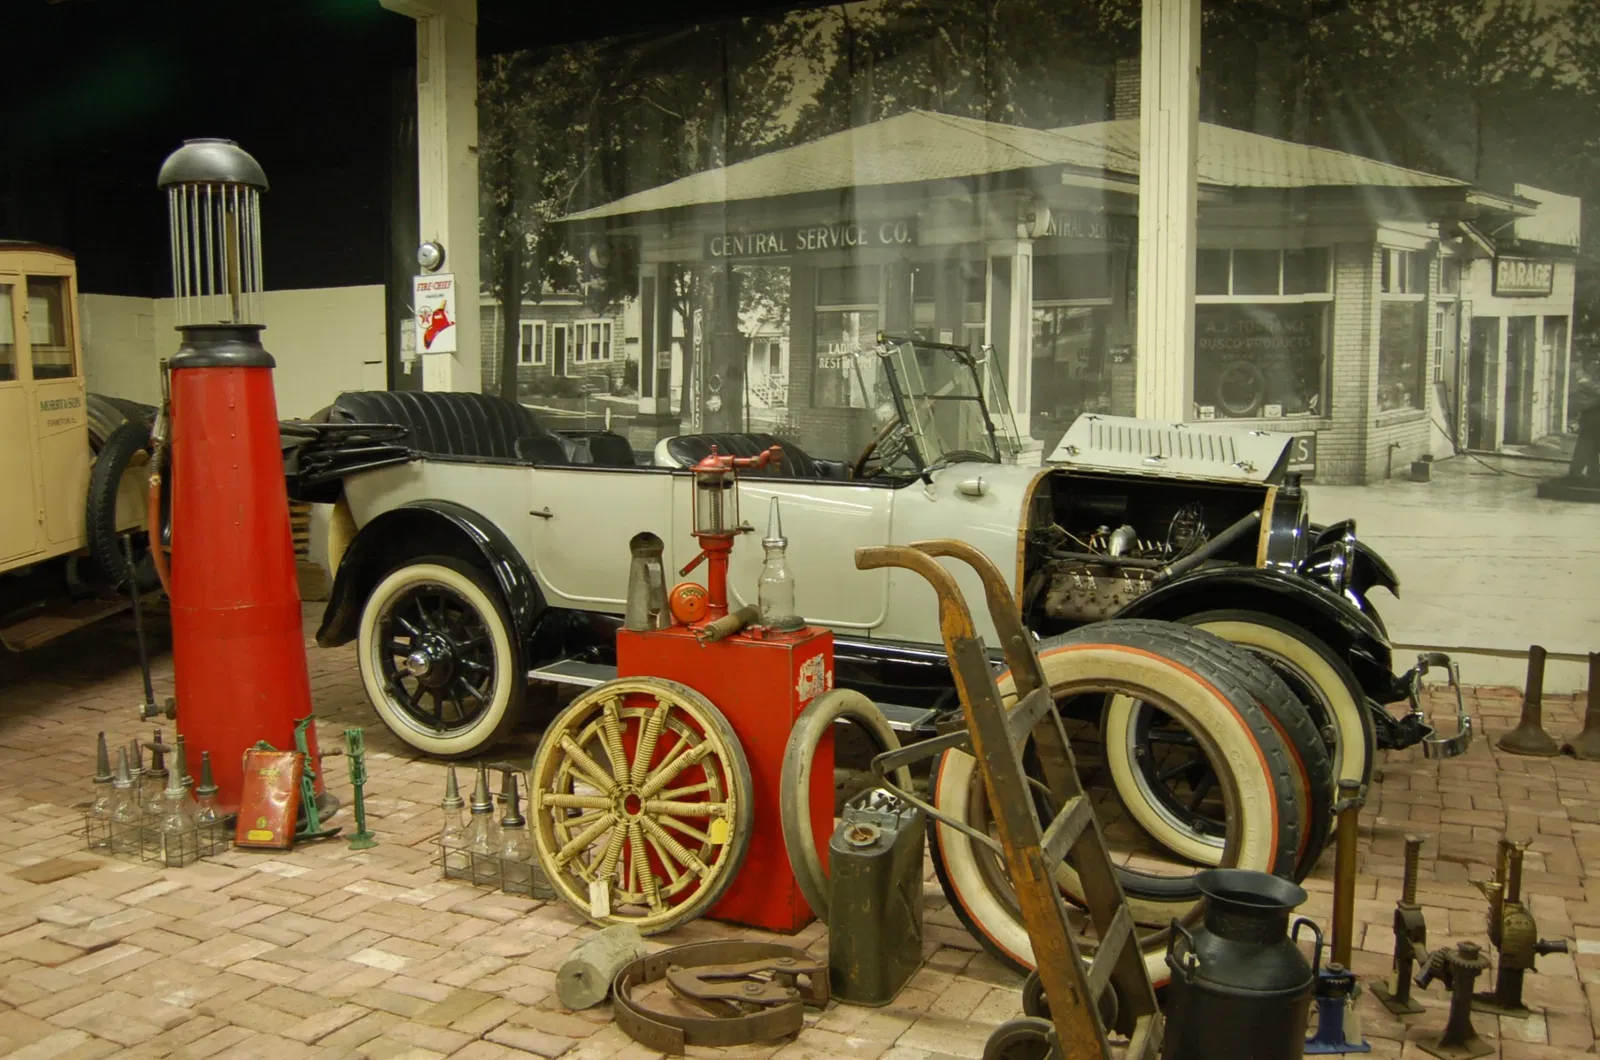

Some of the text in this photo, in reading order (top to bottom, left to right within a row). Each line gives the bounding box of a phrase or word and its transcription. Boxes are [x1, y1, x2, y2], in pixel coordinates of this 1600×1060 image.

[1046, 215, 1084, 237] NTRAL
[710, 220, 912, 257] CENTRAL SERVICE CO.
[1498, 260, 1551, 288] GARAGE
[417, 280, 452, 292] FIRE-CHIEF
[1246, 335, 1312, 349] PRODUCTS
